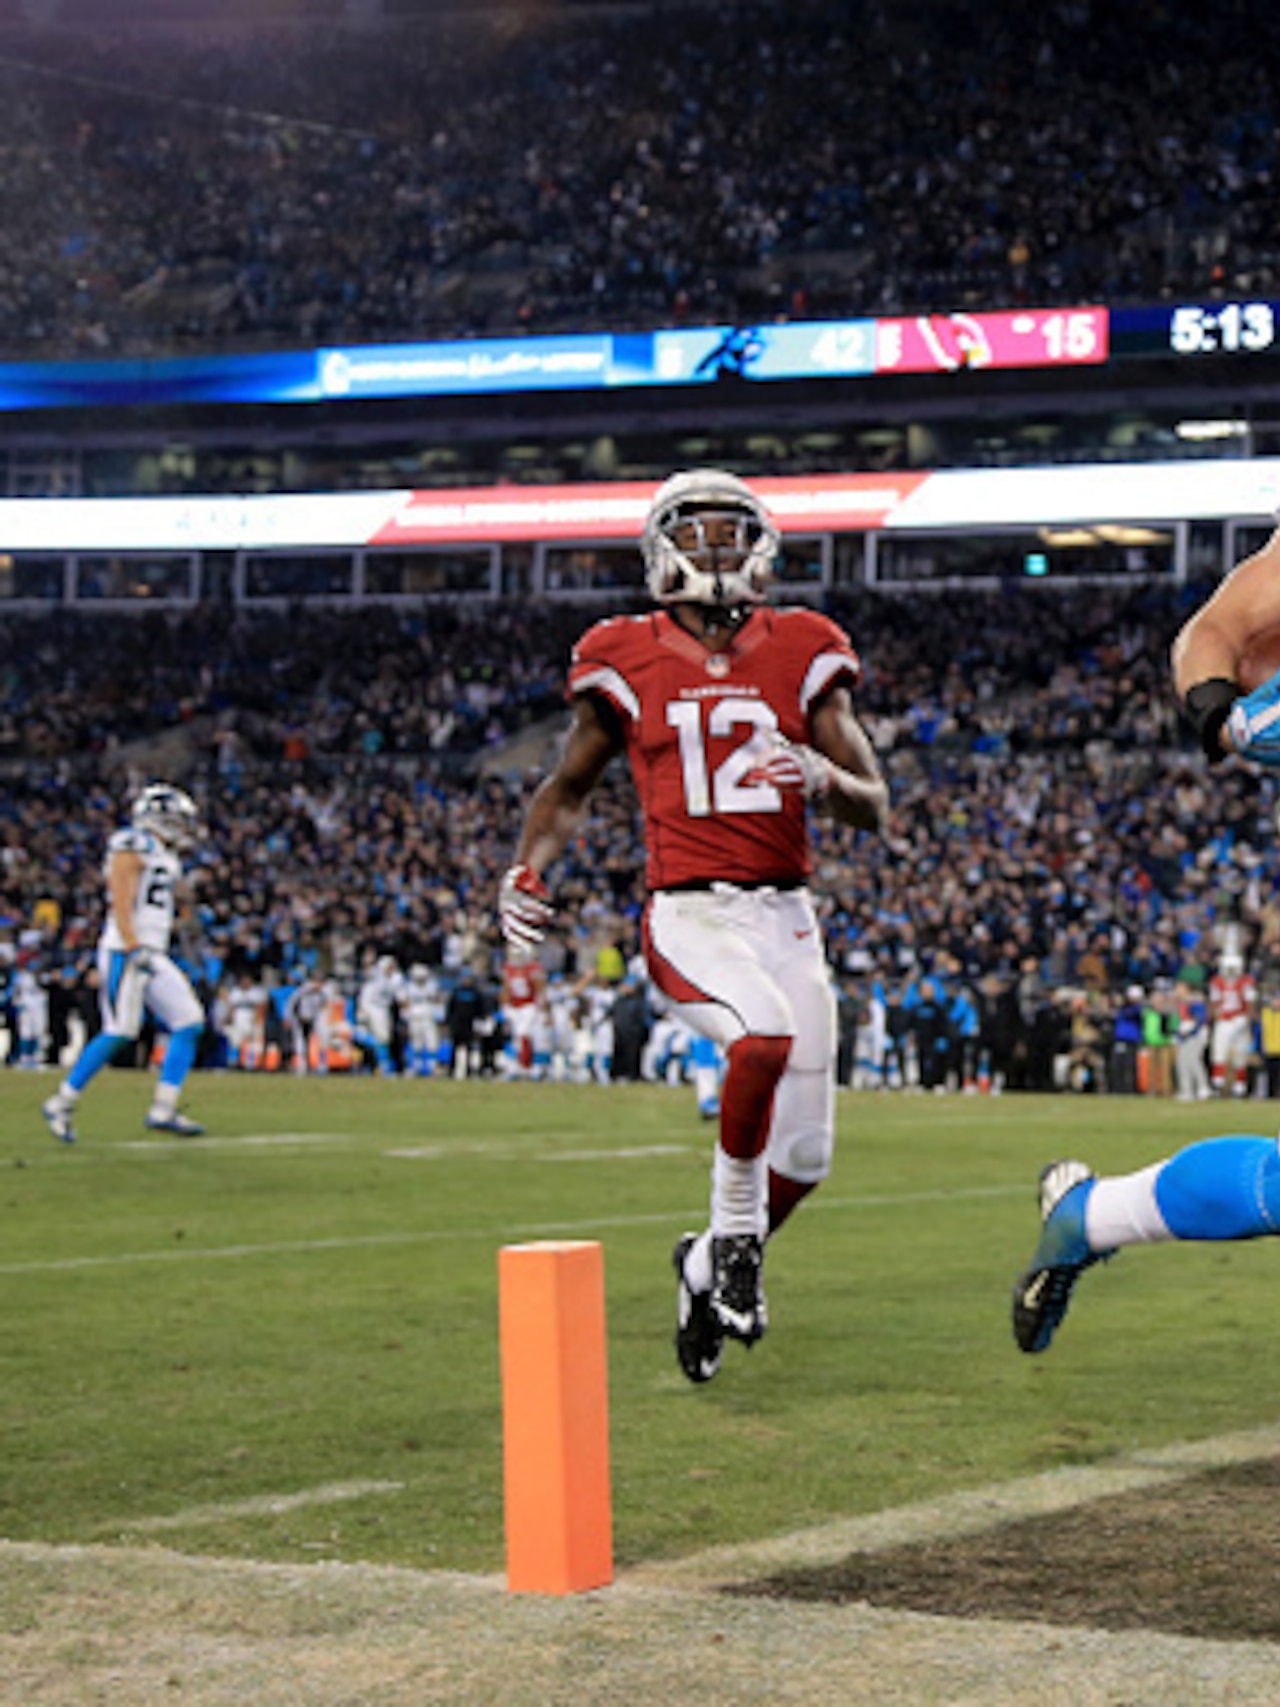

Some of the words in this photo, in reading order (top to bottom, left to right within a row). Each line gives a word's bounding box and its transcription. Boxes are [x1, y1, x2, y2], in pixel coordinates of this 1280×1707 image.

[811, 327, 863, 369] 42
[1041, 314, 1096, 358] 15
[1170, 304, 1274, 352] 5:13
[666, 697, 783, 818] 12
